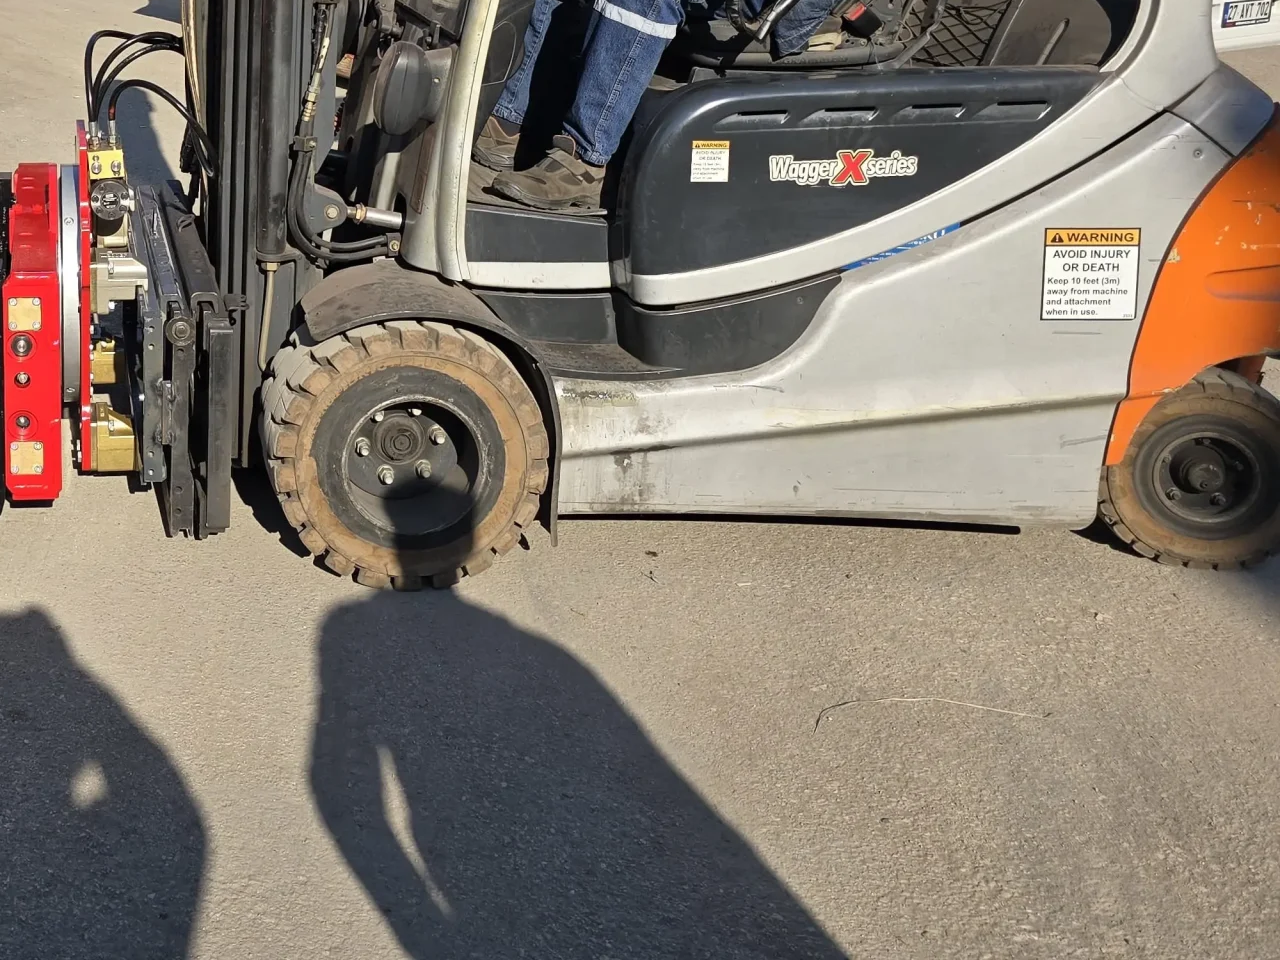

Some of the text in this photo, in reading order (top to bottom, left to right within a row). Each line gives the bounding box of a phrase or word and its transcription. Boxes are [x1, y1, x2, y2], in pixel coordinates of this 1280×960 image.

[1227, 4, 1238, 21] 27
[1067, 232, 1134, 242] WARNING
[1053, 249, 1131, 259] AVOID INJURY
[1062, 262, 1120, 272] OR DEATH
[1047, 277, 1120, 286] Keep 10 feet (3m)
[1046, 287, 1128, 296] away from machine
[1046, 297, 1111, 305] and attachment
